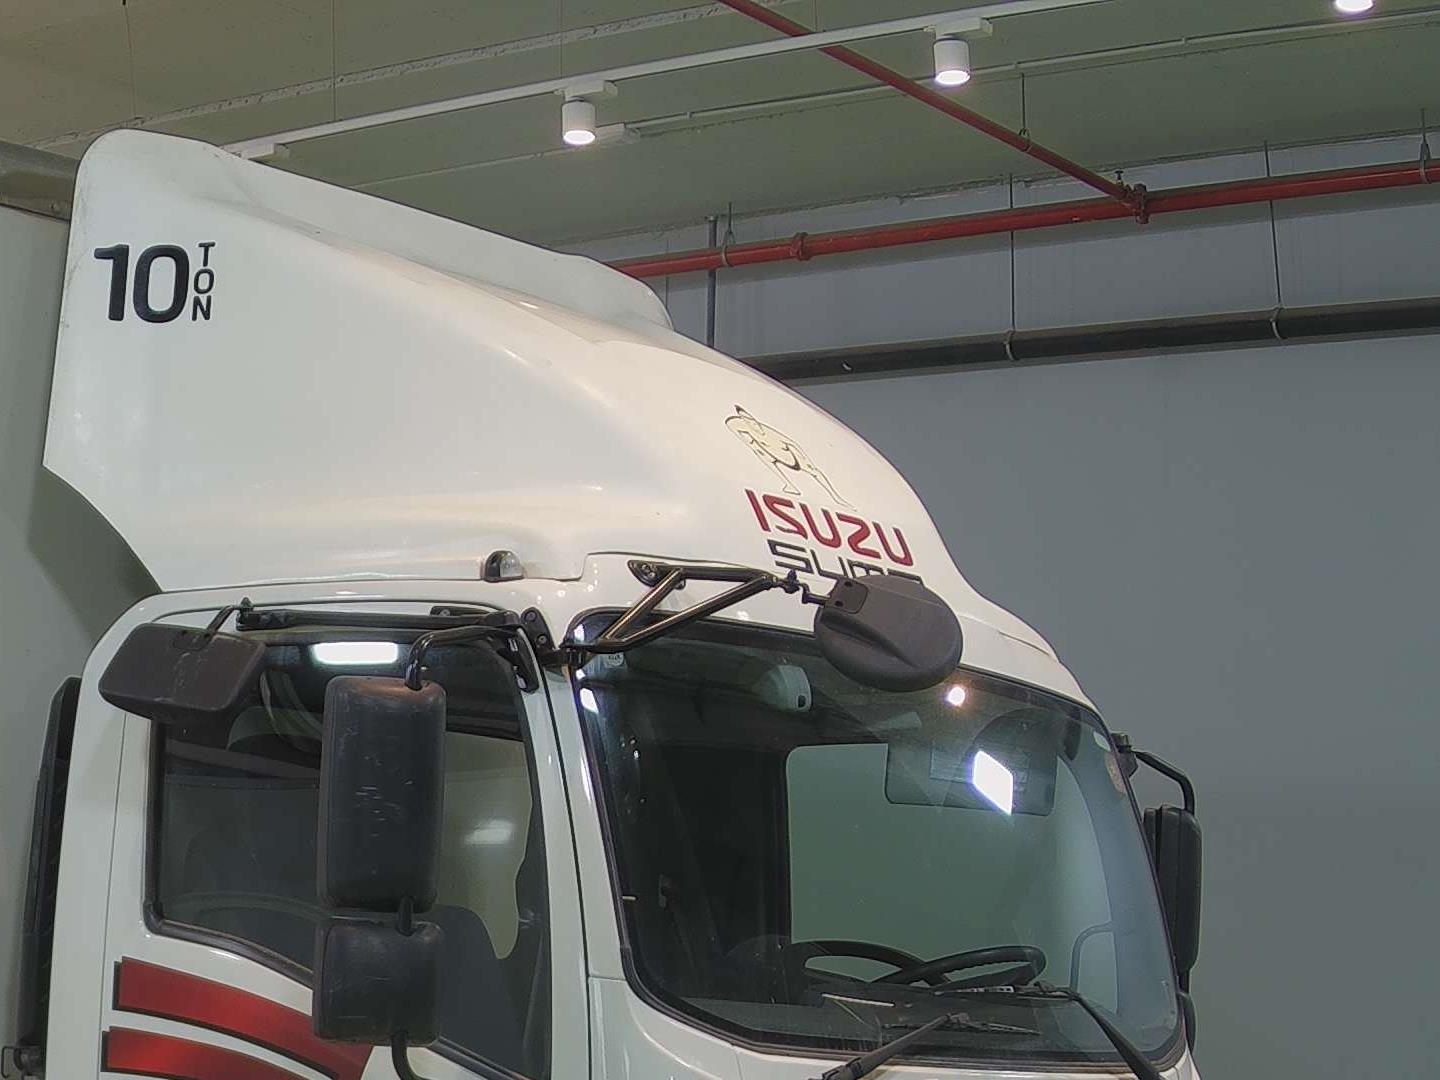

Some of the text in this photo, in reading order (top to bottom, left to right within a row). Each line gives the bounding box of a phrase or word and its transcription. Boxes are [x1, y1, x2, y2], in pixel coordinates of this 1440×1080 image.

[93, 241, 216, 323] 10 TON
[745, 488, 913, 567] ISUZU
[767, 539, 924, 579] SUM
